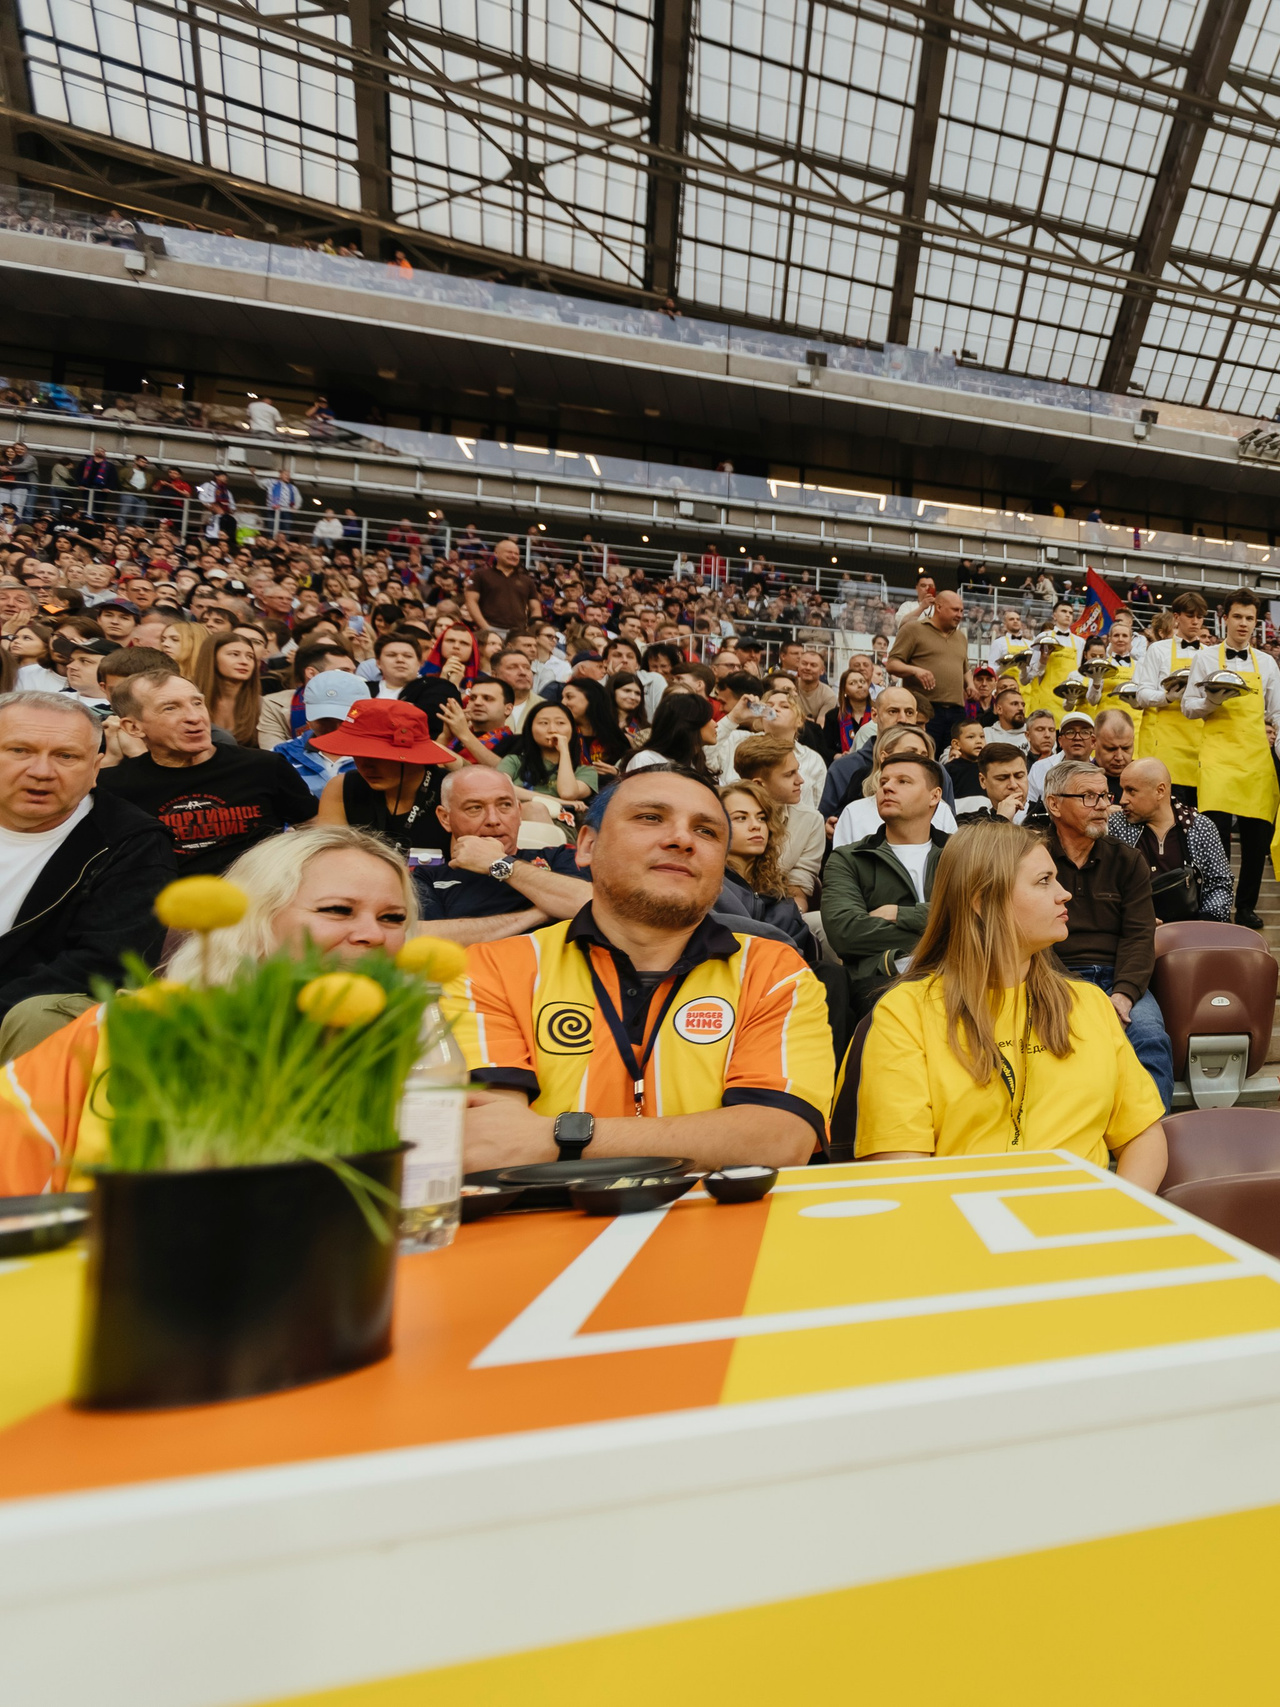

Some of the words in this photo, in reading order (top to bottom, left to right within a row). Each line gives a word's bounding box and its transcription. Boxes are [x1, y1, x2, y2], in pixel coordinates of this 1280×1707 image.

[158, 805, 262, 827] ПОРТИВНОЕ
[686, 1012, 723, 1020] BURGER
[685, 1019, 722, 1029] KING
